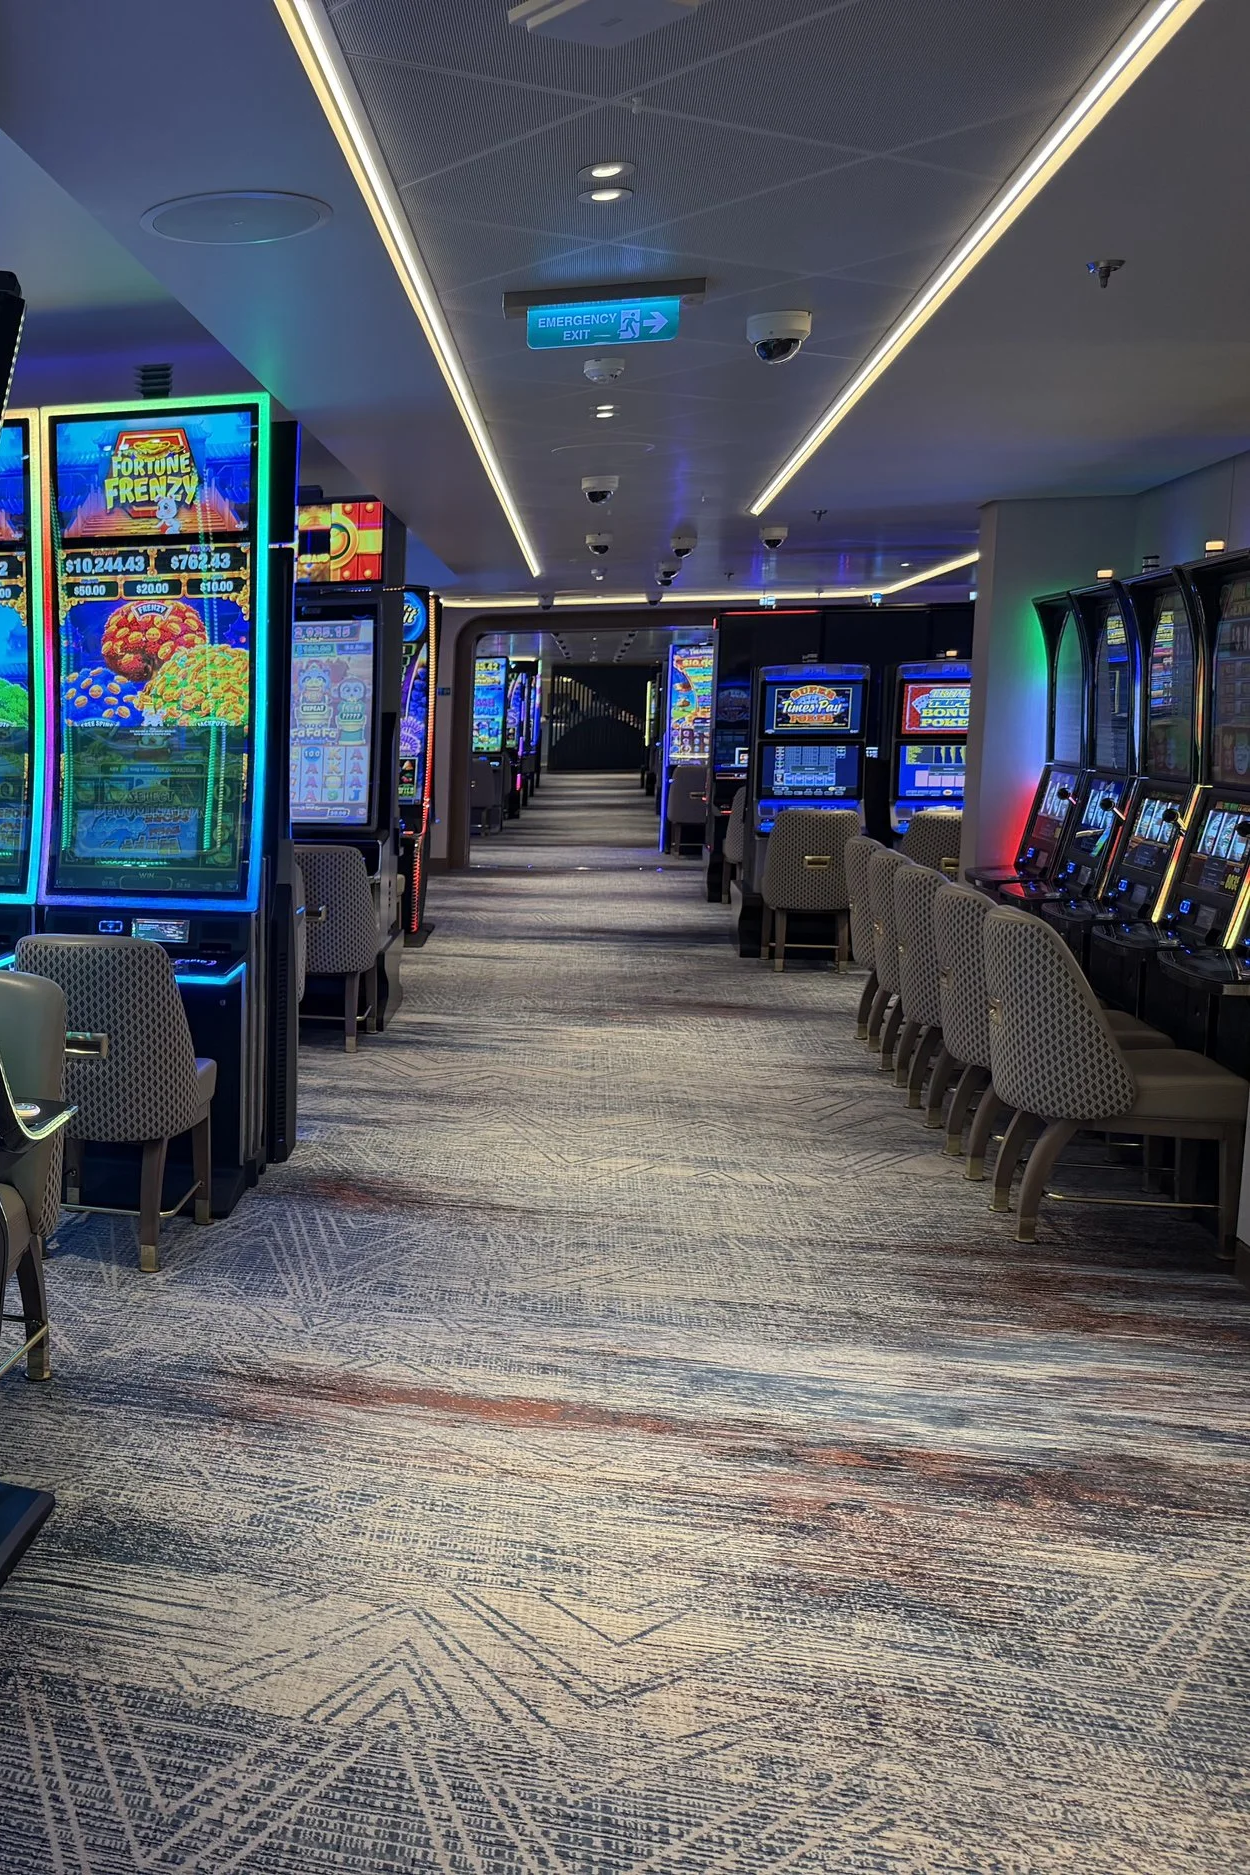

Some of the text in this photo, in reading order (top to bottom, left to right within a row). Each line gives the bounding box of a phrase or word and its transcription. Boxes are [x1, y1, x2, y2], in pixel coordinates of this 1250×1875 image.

[537, 312, 617, 328] EMERGENCY
[562, 329, 590, 341] EXIT
[111, 452, 191, 477] FORTUNE
[105, 474, 198, 513] FRENZY
[65, 555, 145, 574] $10,244.43
[170, 552, 231, 570] $762.43
[74, 585, 106, 596] $50.00
[136, 583, 169, 594] $20.00
[199, 581, 234, 593] $10.00
[137, 603, 166, 615] FRENZY
[790, 685, 836, 700] SUPER
[782, 699, 843, 715] Times Pay
[921, 708, 970, 717] BONU
[789, 714, 835, 723] POKER
[920, 718, 969, 727] POKE
[350, 749, 364, 760] A
[350, 762, 363, 774] A
[349, 776, 363, 788] A
